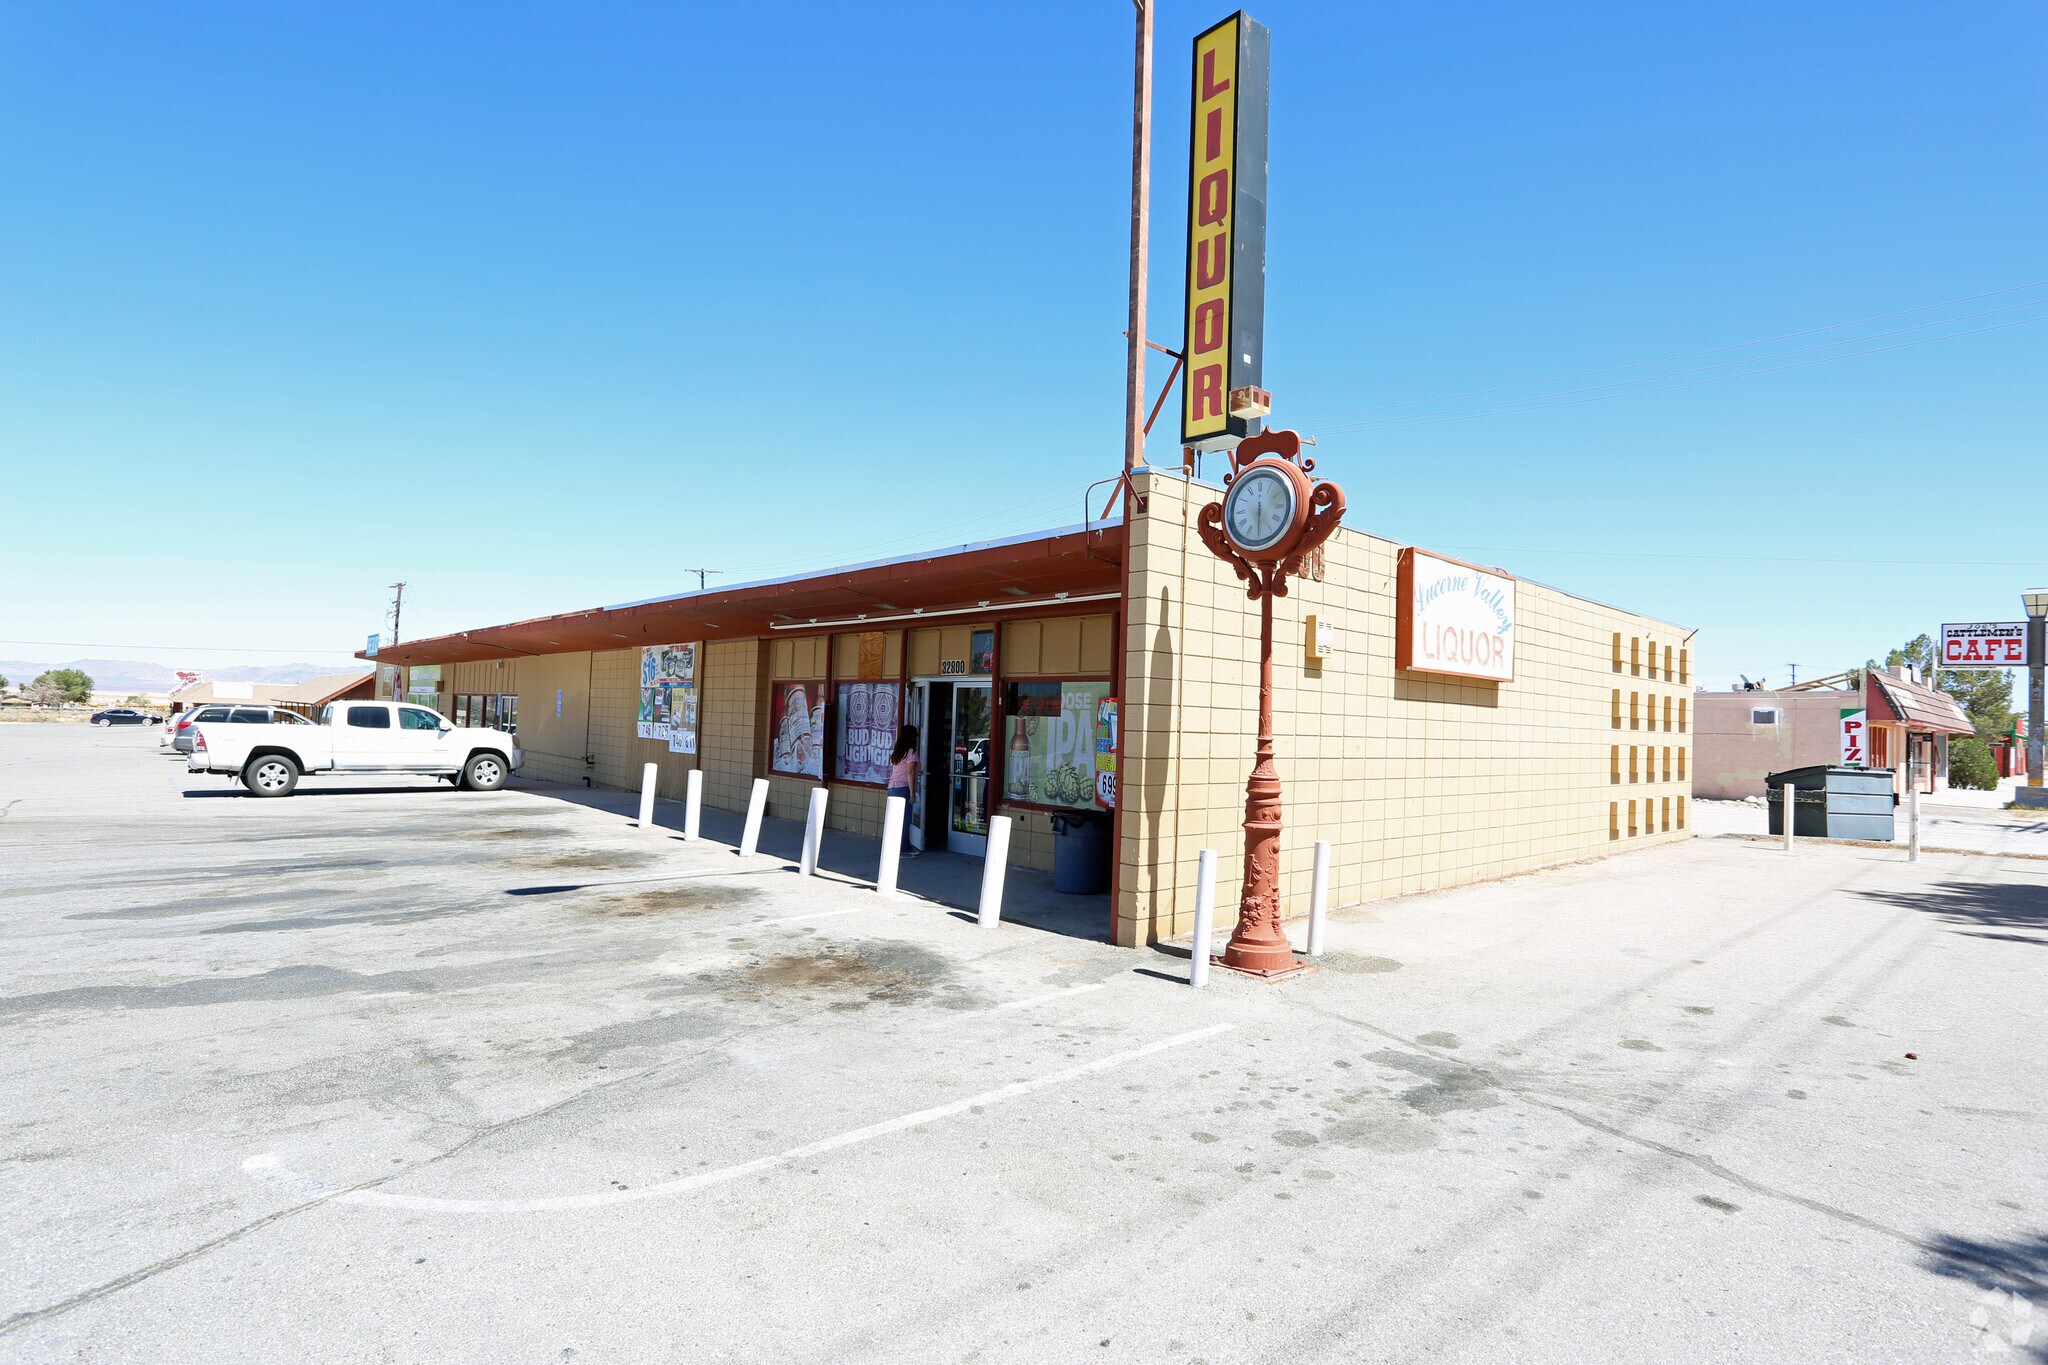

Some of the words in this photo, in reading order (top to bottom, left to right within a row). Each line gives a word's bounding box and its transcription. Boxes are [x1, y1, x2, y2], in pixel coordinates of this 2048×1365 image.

[1192, 48, 1230, 422] LIQUOR
[1414, 575, 1469, 616] Lucerne
[1473, 571, 1513, 635] Valley
[1946, 625, 2023, 638] CATTLEMEN'S
[1422, 621, 1505, 670] LIQUOR
[1946, 639, 2023, 661] CAFE
[942, 660, 966, 675] 32800
[1062, 692, 1092, 710] OSE
[848, 728, 869, 745] BUD
[871, 729, 893, 750] BUD
[1045, 709, 1096, 780] IPA
[1844, 721, 1862, 766] PIZ
[871, 746, 893, 767] IGH
